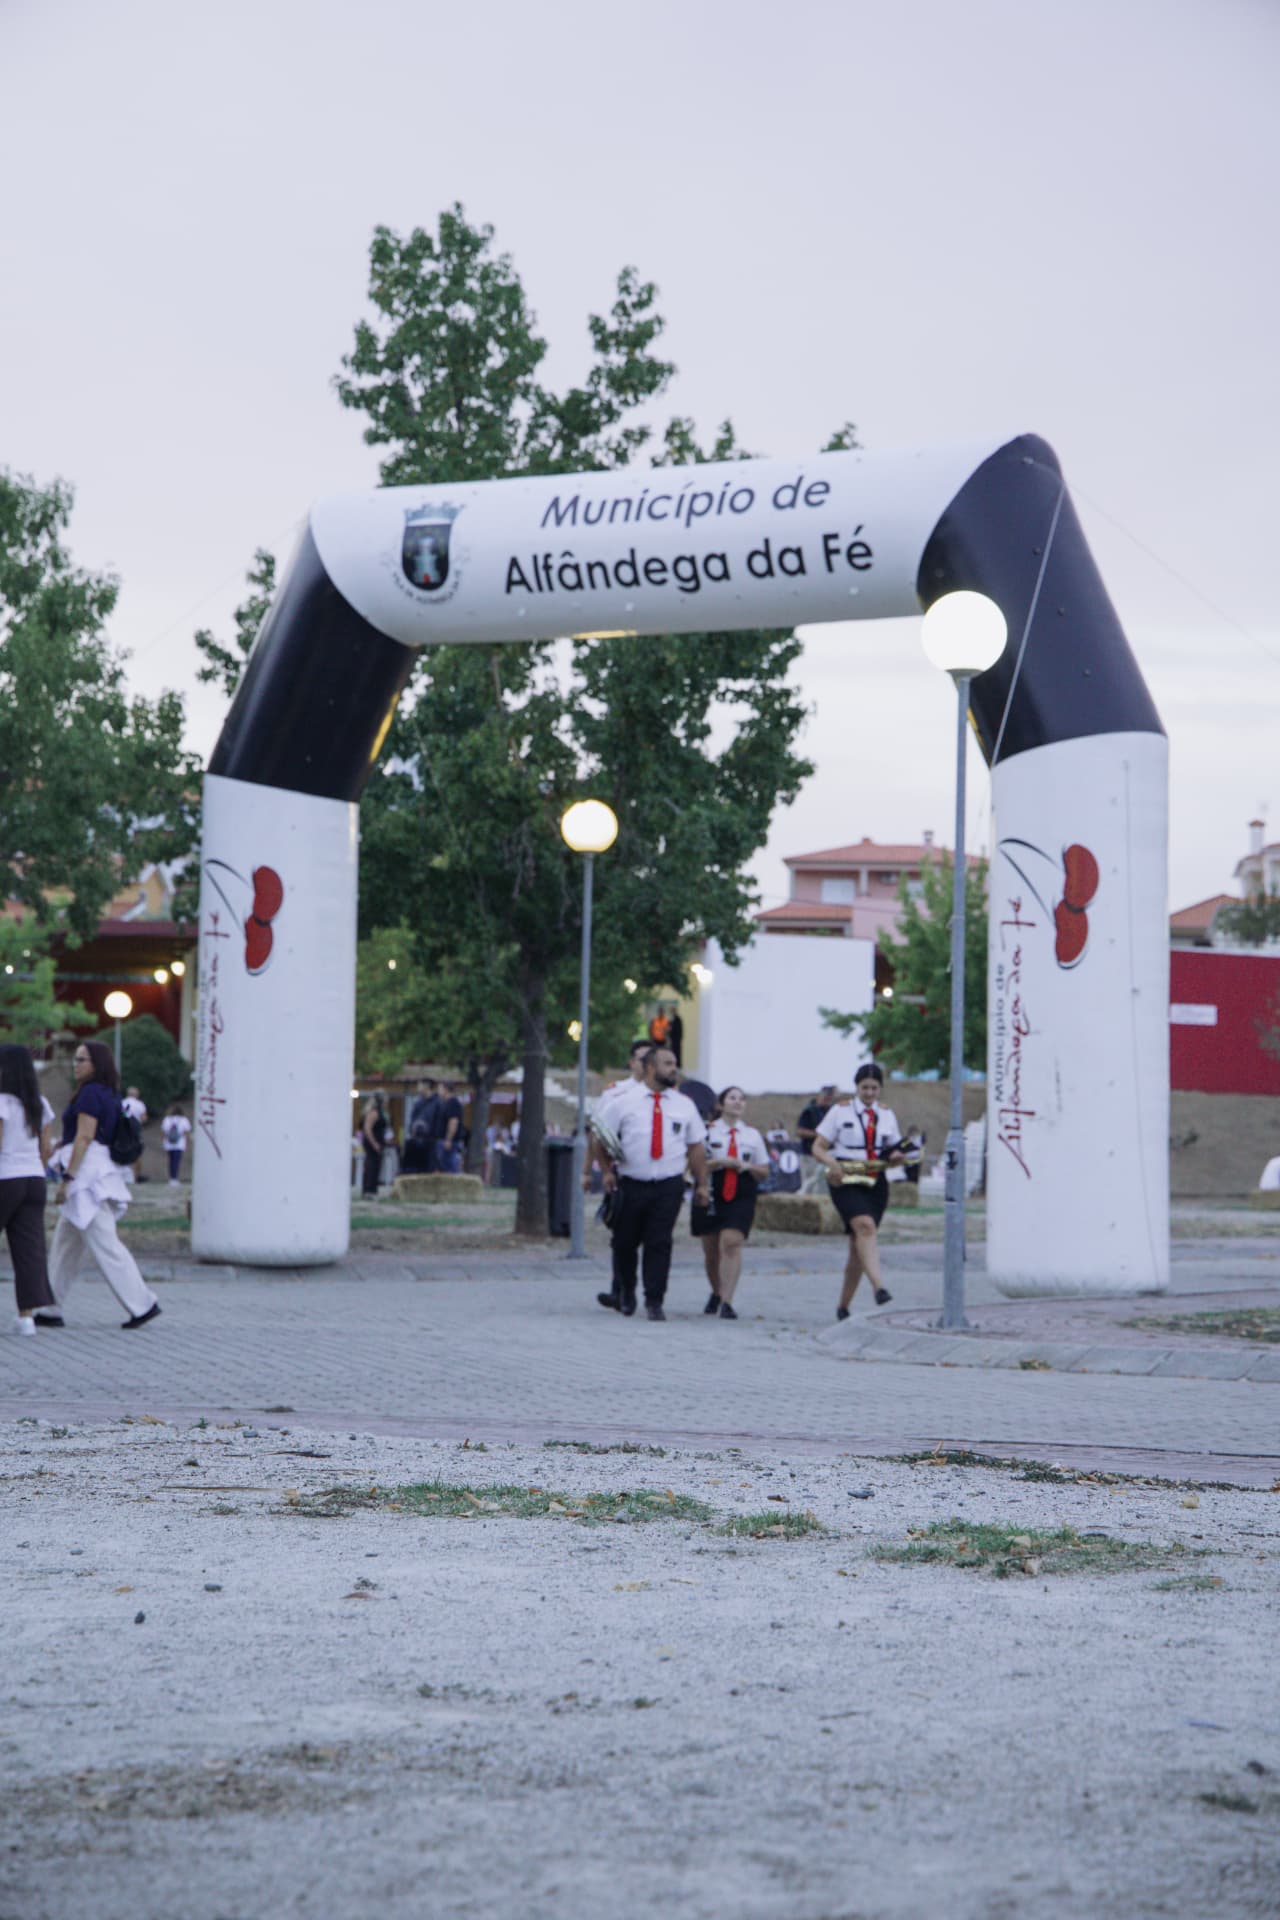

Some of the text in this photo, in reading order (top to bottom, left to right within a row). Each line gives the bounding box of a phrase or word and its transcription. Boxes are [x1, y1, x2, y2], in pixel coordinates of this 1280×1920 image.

[540, 475, 831, 528] Município de
[505, 547, 731, 593] Alfândega
[746, 537, 806, 578] da
[822, 524, 873, 573] Fé
[995, 963, 1004, 990] de
